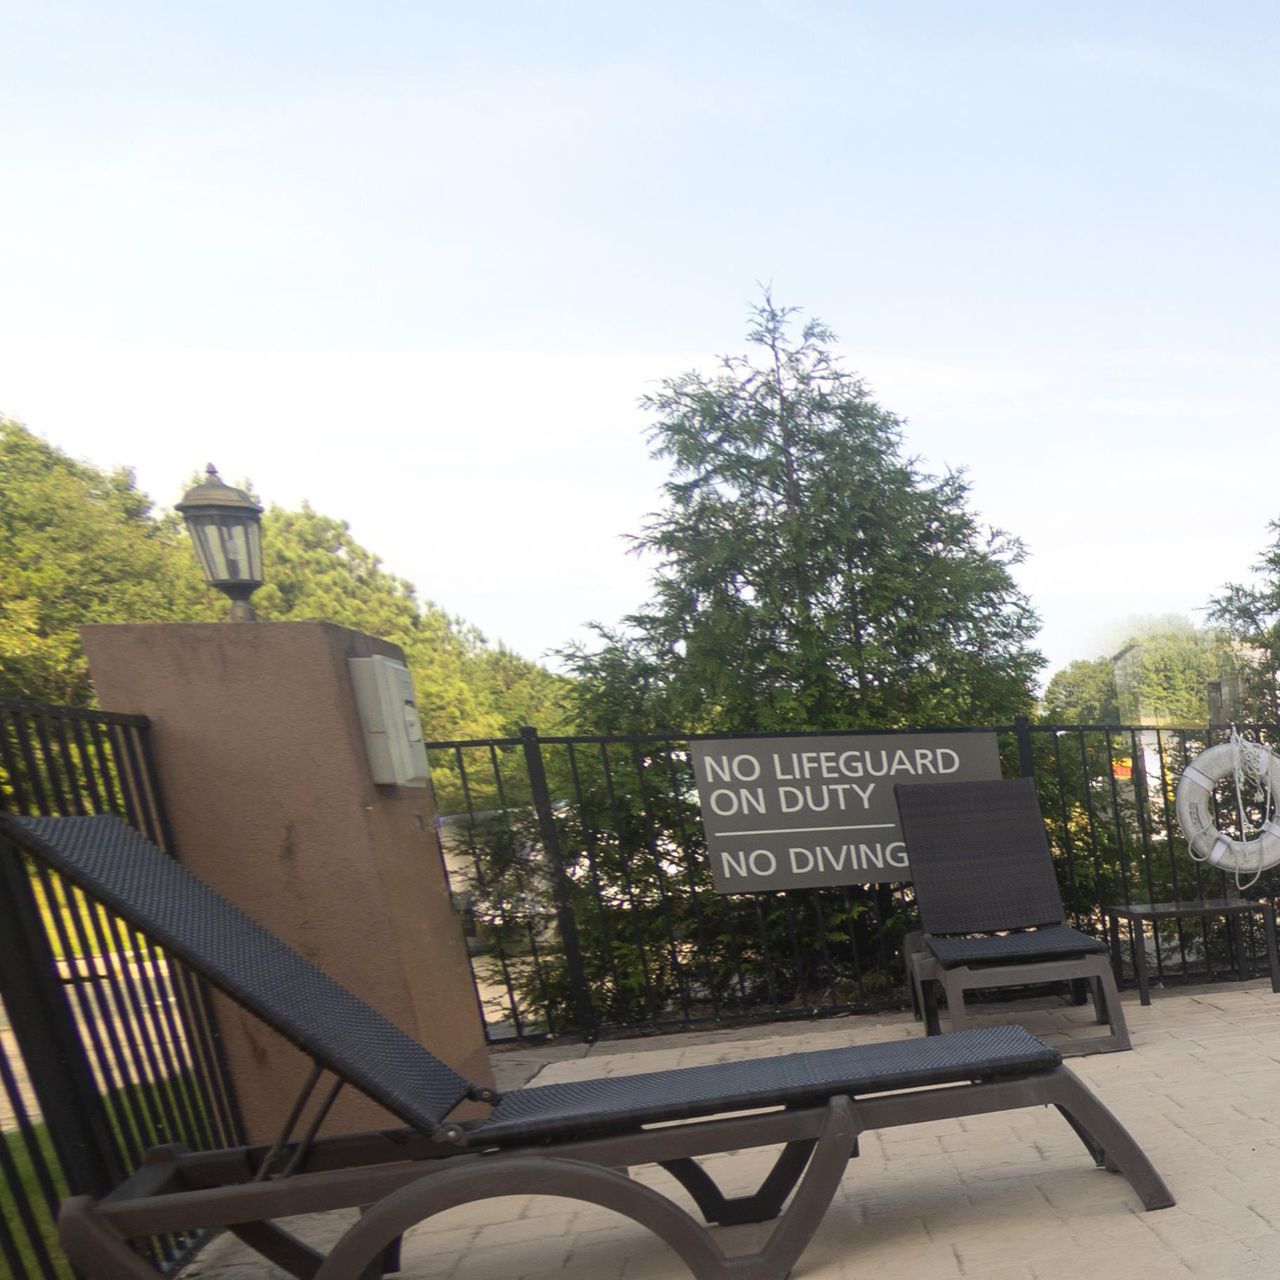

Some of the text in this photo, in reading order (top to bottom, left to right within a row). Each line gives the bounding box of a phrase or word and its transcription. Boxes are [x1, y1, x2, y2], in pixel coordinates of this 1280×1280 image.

[703, 748, 960, 783] NO LIFEGUARD
[710, 783, 876, 816] ON DUTY
[720, 841, 910, 878] NO DIVING
